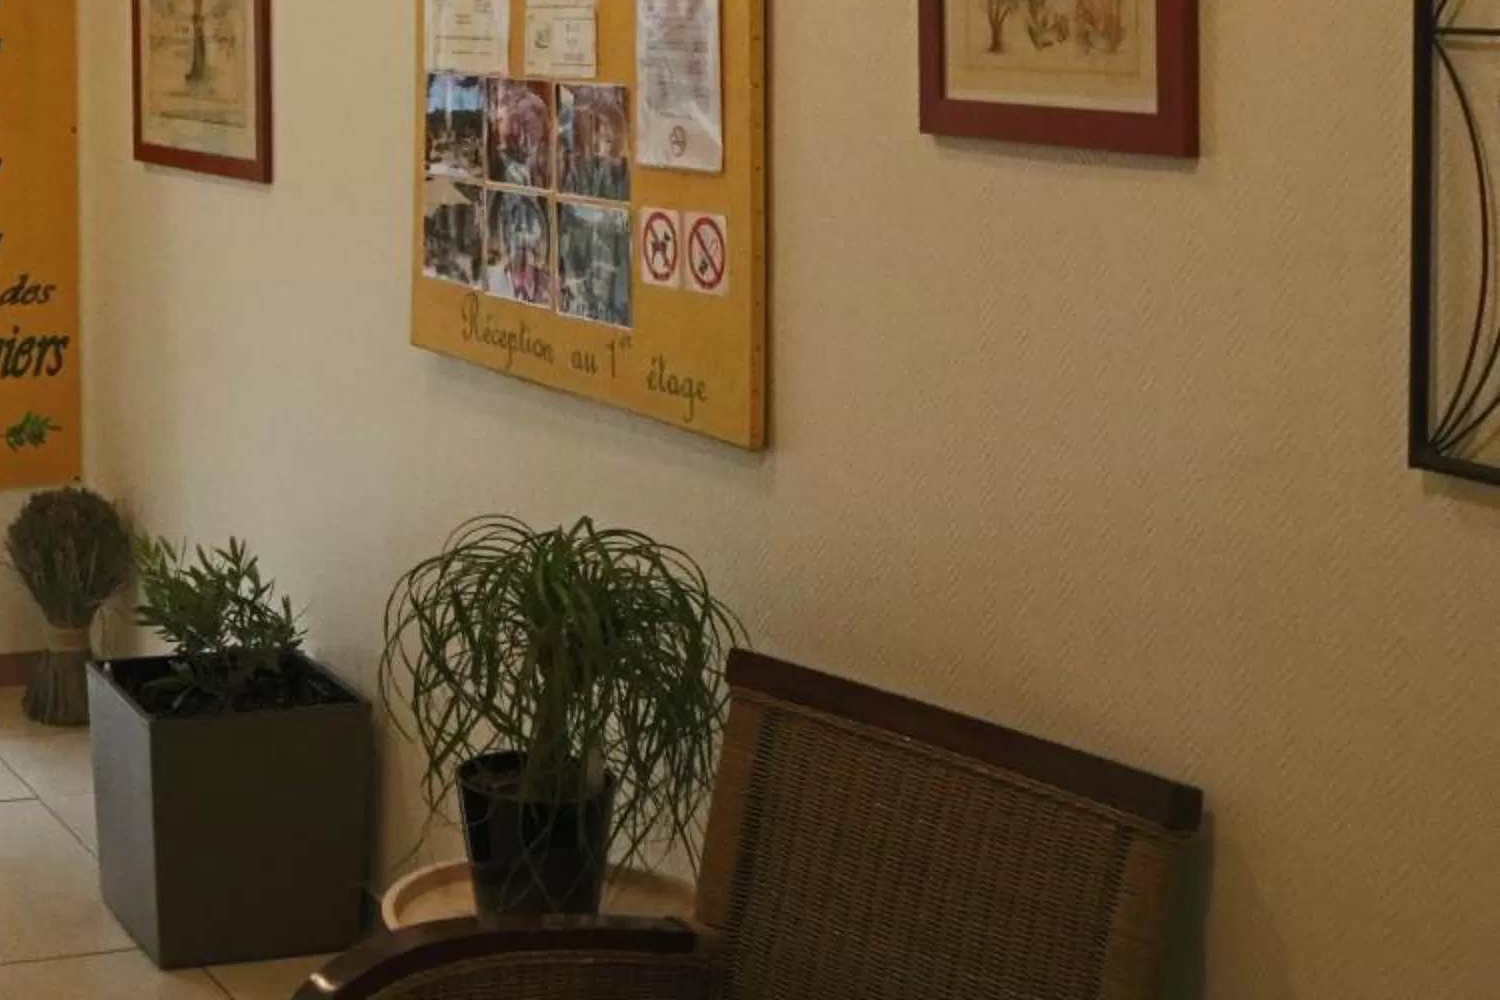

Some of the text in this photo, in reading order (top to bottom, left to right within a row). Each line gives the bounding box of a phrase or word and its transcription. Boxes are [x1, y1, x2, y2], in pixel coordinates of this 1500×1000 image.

[0, 274, 56, 307] des
[460, 292, 555, 371] Réception
[570, 349, 598, 375] au
[647, 352, 708, 424] étage
